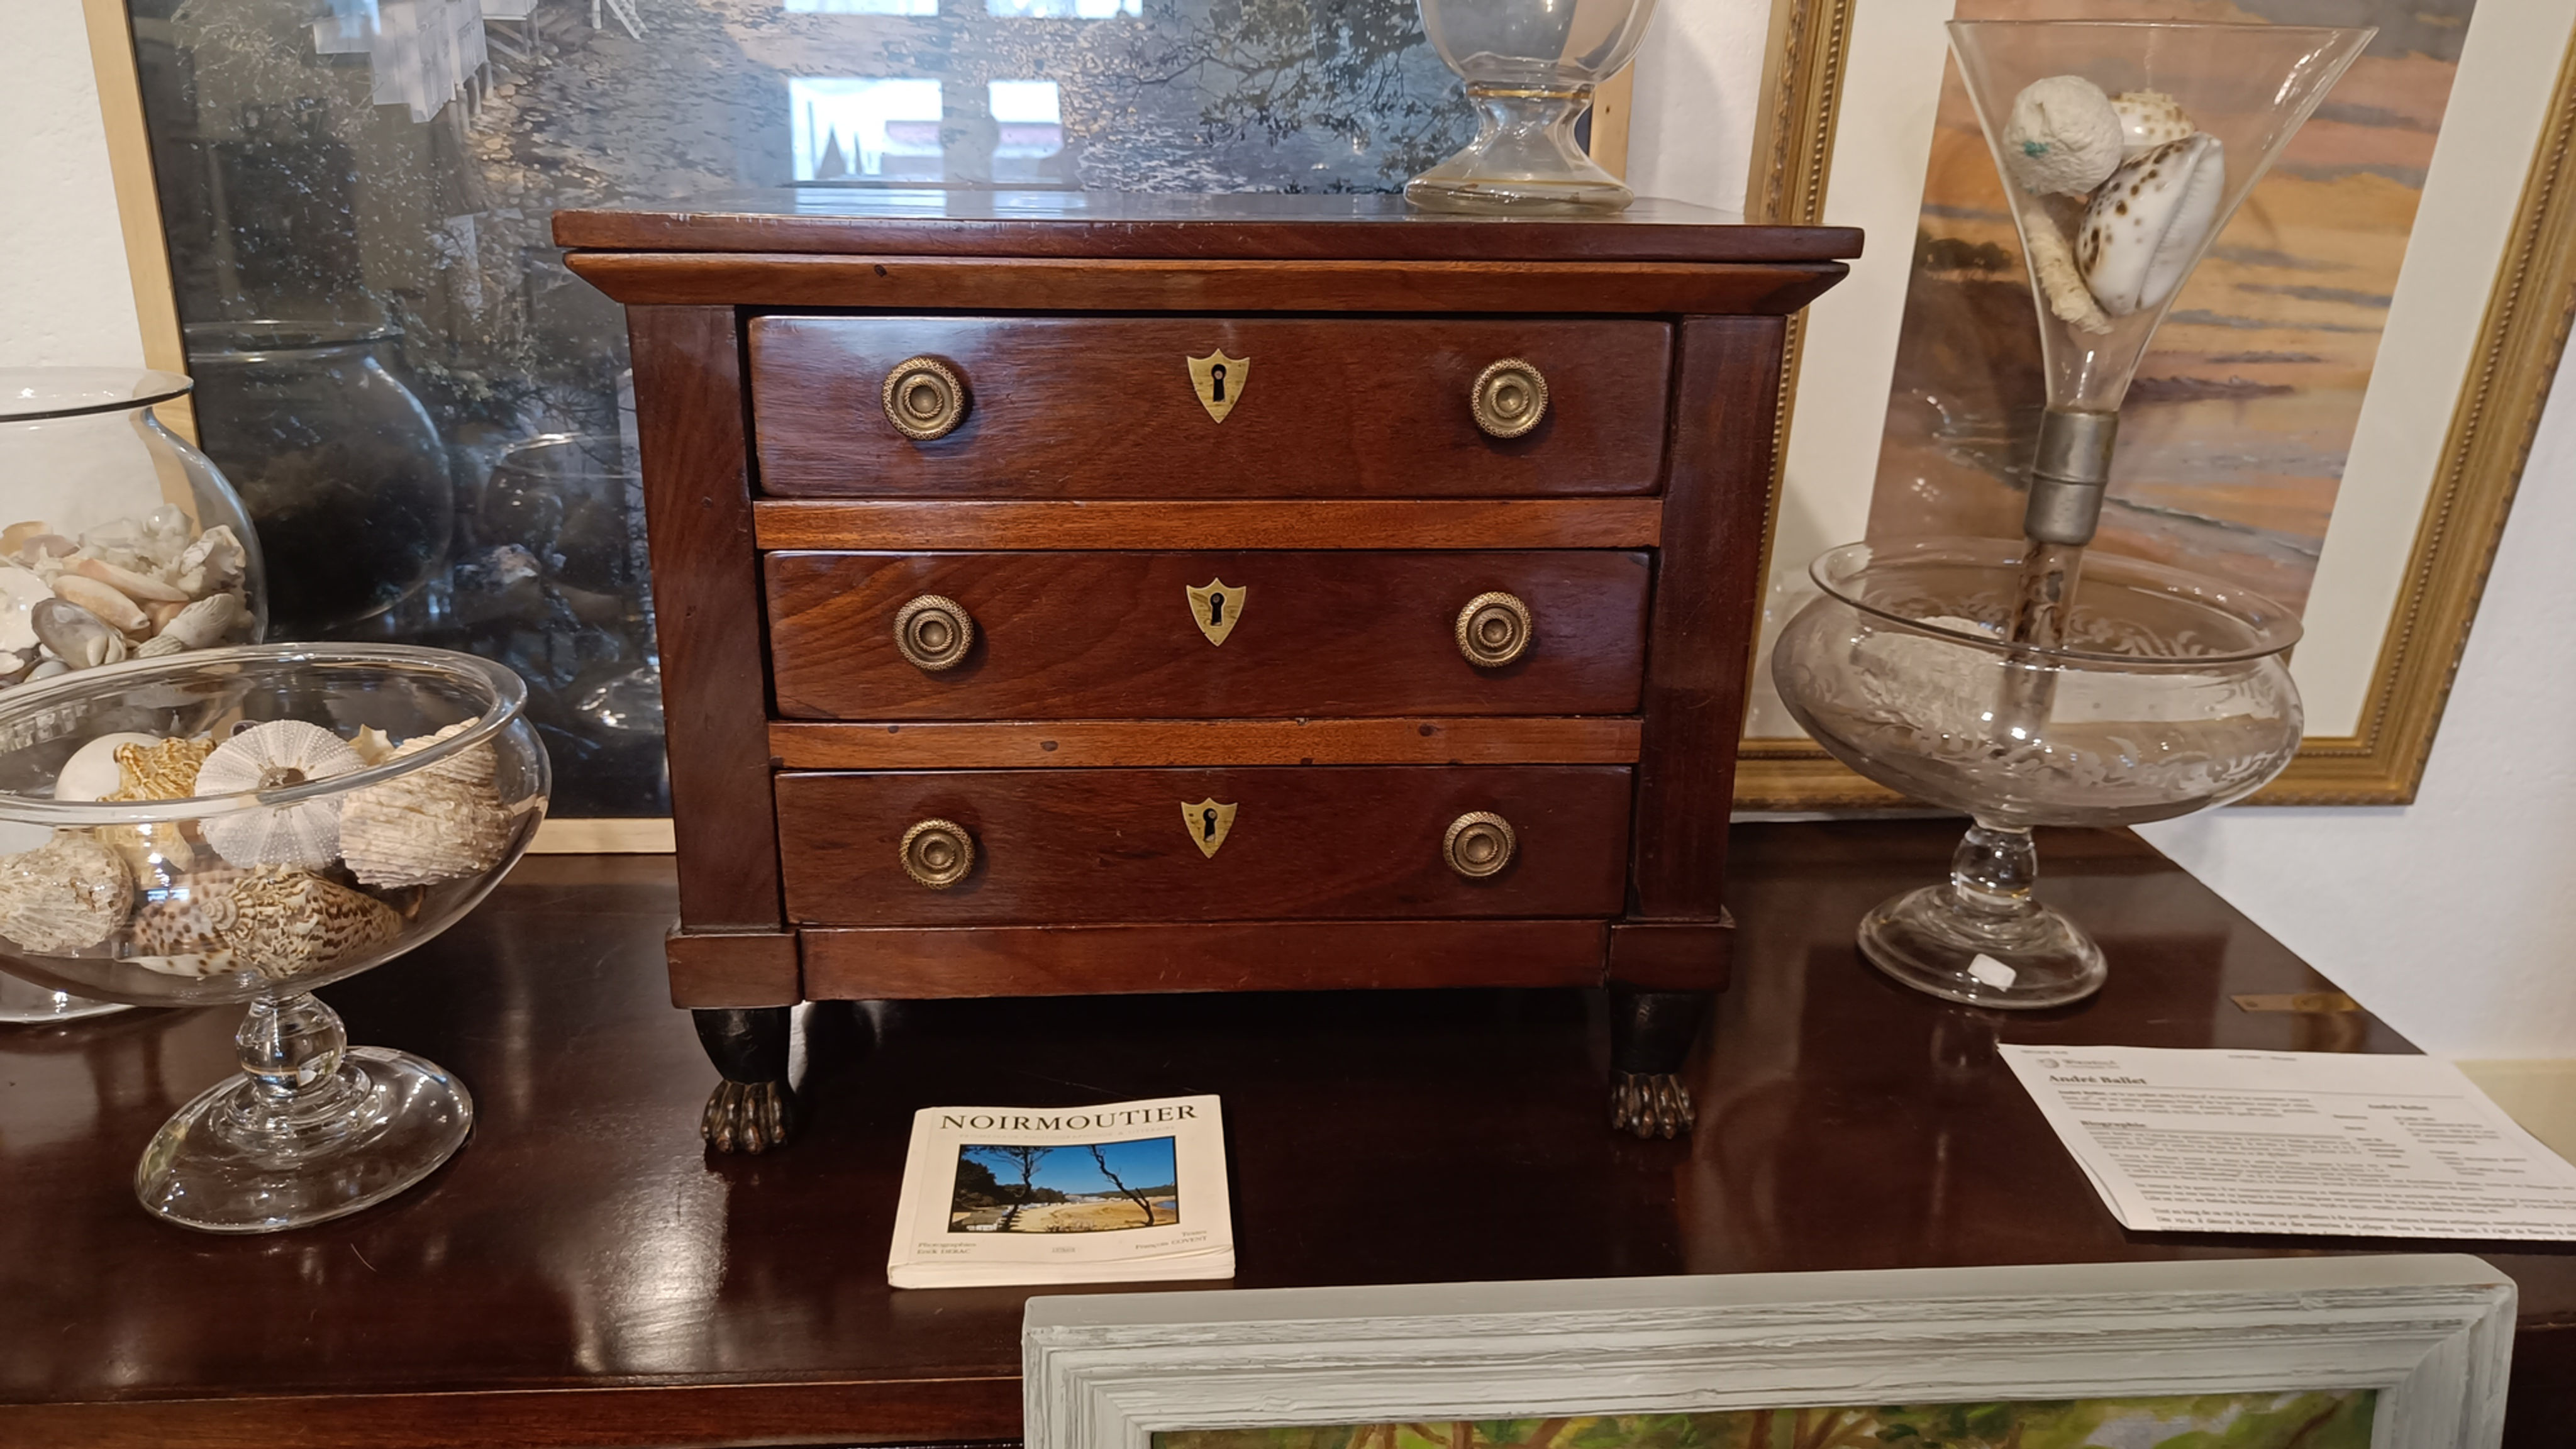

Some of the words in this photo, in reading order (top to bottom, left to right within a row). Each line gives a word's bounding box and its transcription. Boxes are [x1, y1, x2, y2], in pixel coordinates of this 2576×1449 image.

[2048, 1074, 2097, 1084] André
[2099, 1076, 2147, 1085] Ballet
[940, 1105, 1199, 1131] NOIRMOUTIER
